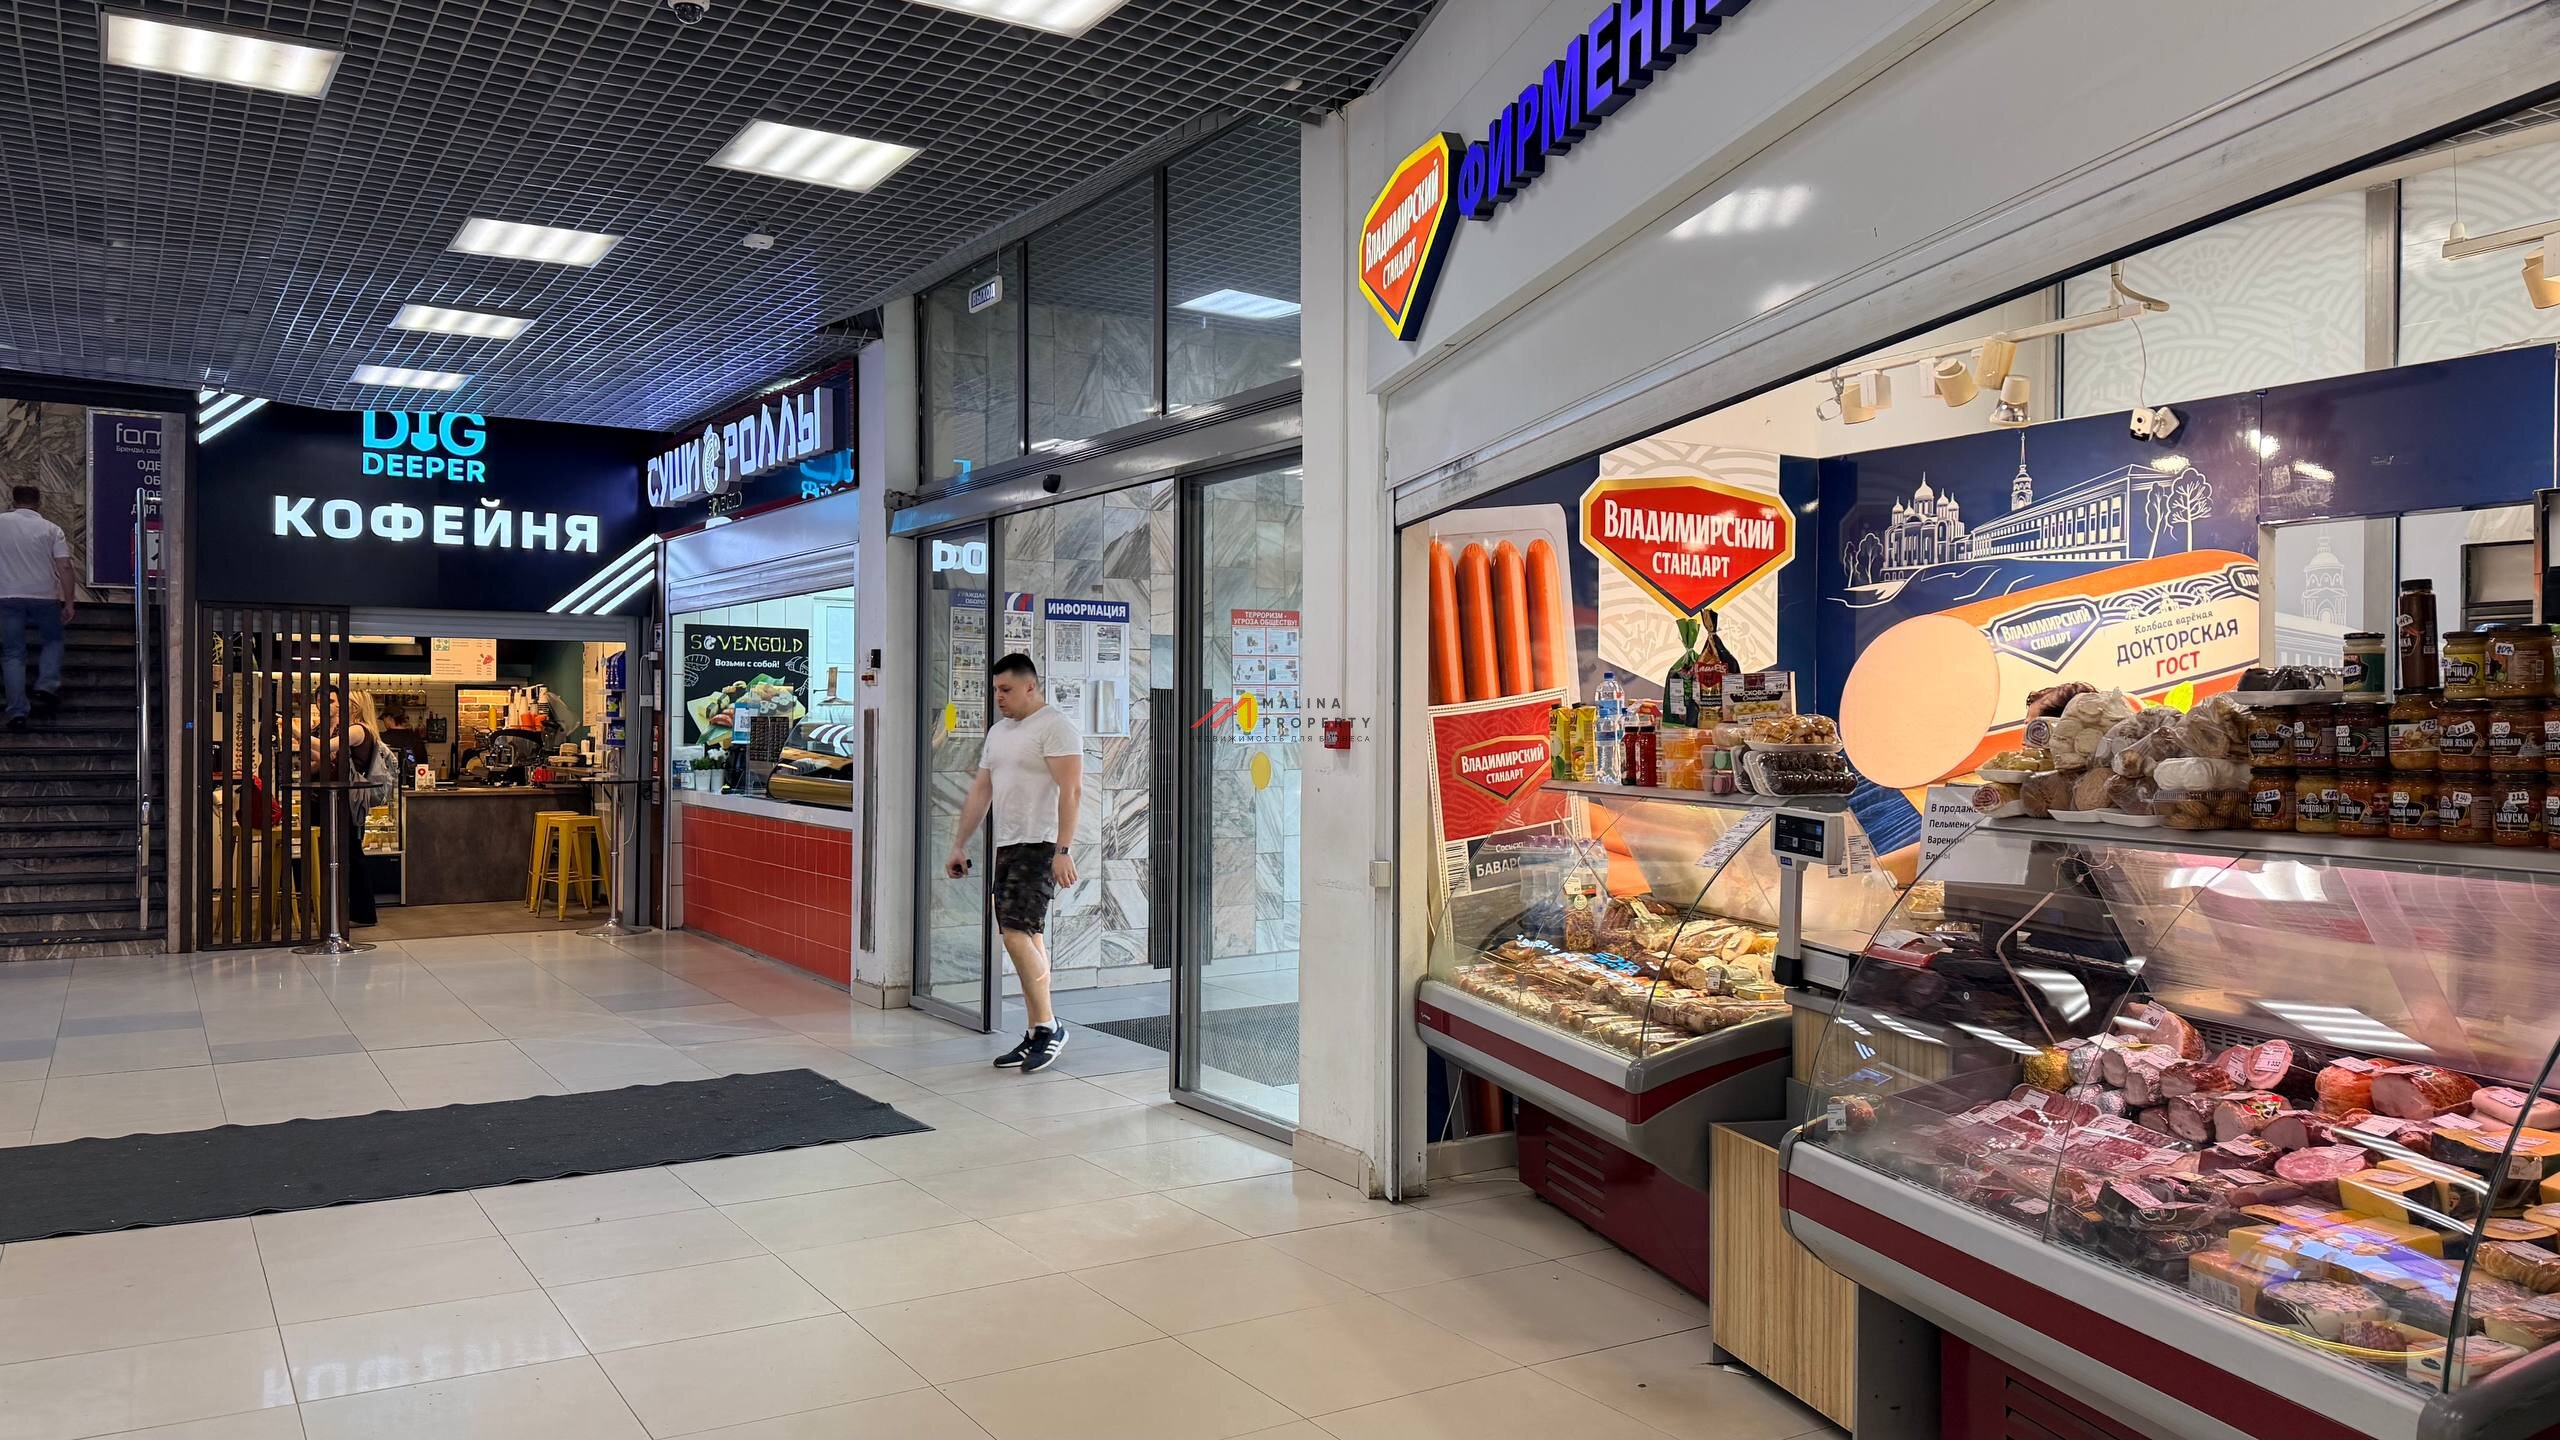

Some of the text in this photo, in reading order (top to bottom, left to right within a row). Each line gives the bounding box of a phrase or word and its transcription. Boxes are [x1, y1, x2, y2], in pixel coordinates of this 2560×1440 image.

[1458, 0, 1732, 220] ФИРМЕН
[1365, 158, 1440, 273] ВЛАДИМИРСКИЙ
[1382, 236, 1417, 290] СТАНДАРТ
[972, 282, 996, 307] ВЫХОД
[362, 410, 486, 456] DIG
[648, 438, 700, 507] СУШИ
[723, 386, 821, 481] РОЛЛЫ
[362, 451, 485, 483] DEEPER
[274, 495, 598, 553] КОФЕЙНЯ
[1604, 499, 1775, 550] ВЛАДИМИРСКИЙ
[1652, 551, 1730, 578] СТАНДАРТ
[1048, 602, 1126, 618] ИНФОРМАЦИЯ
[1245, 611, 1283, 619] ТЕРРОРИЗМ
[2134, 609, 2214, 634] Колбаса варёная
[2000, 606, 2092, 642] ВЛАДИМИРСКИЙ
[2030, 632, 2071, 651] СТАНДАРТ
[2117, 618, 2239, 667] ДОКТОРСКАЯ
[715, 659, 745, 667] Возьми
[753, 660, 780, 668] собой!
[2156, 651, 2201, 677] ГОСТ
[1461, 744, 1544, 773] ВЛАДИМИРСКИЙ
[1486, 768, 1524, 784] СТАНДАРТ
[1931, 803, 1937, 813] В
[2253, 803, 2272, 812] ХАРЧО
[2497, 812, 2529, 824] ЗАКУСКА
